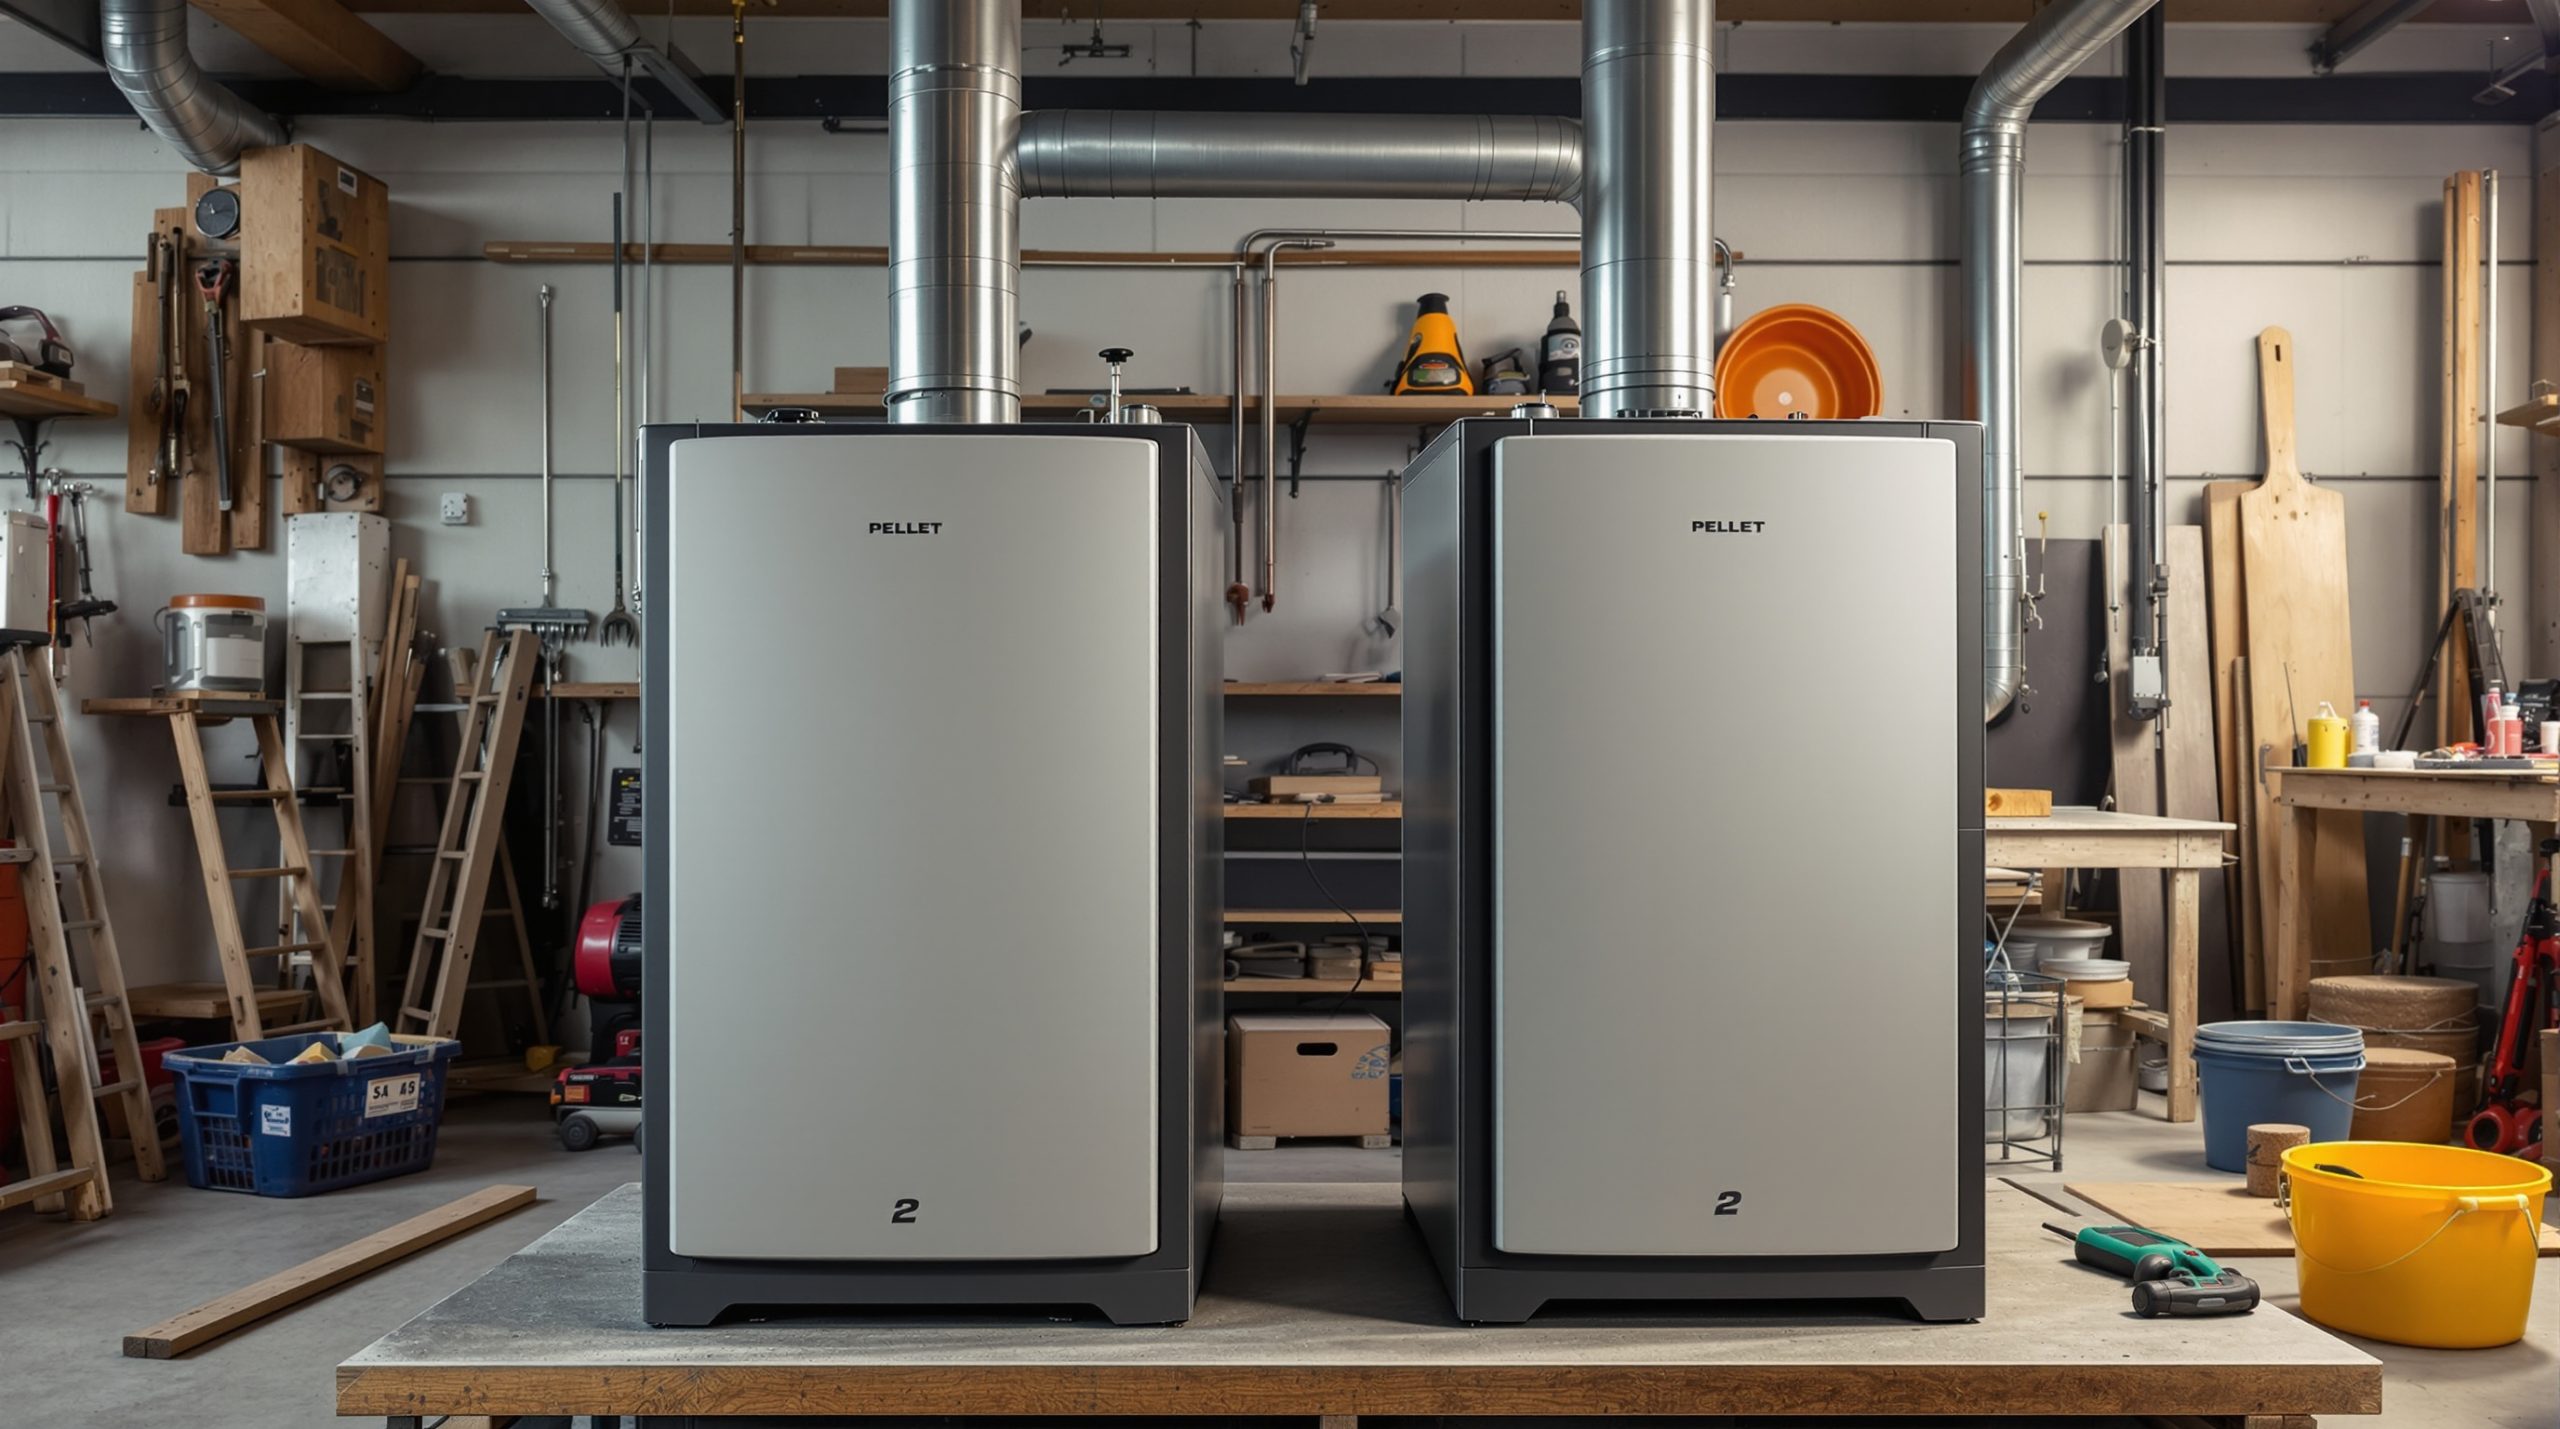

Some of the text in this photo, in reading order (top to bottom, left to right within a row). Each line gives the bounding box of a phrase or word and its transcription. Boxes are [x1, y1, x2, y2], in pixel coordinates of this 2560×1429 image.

[868, 521, 943, 535] PELLET
[1691, 520, 1766, 533] PELLET
[891, 1198, 920, 1225] 2
[1713, 1190, 1743, 1216] 2
